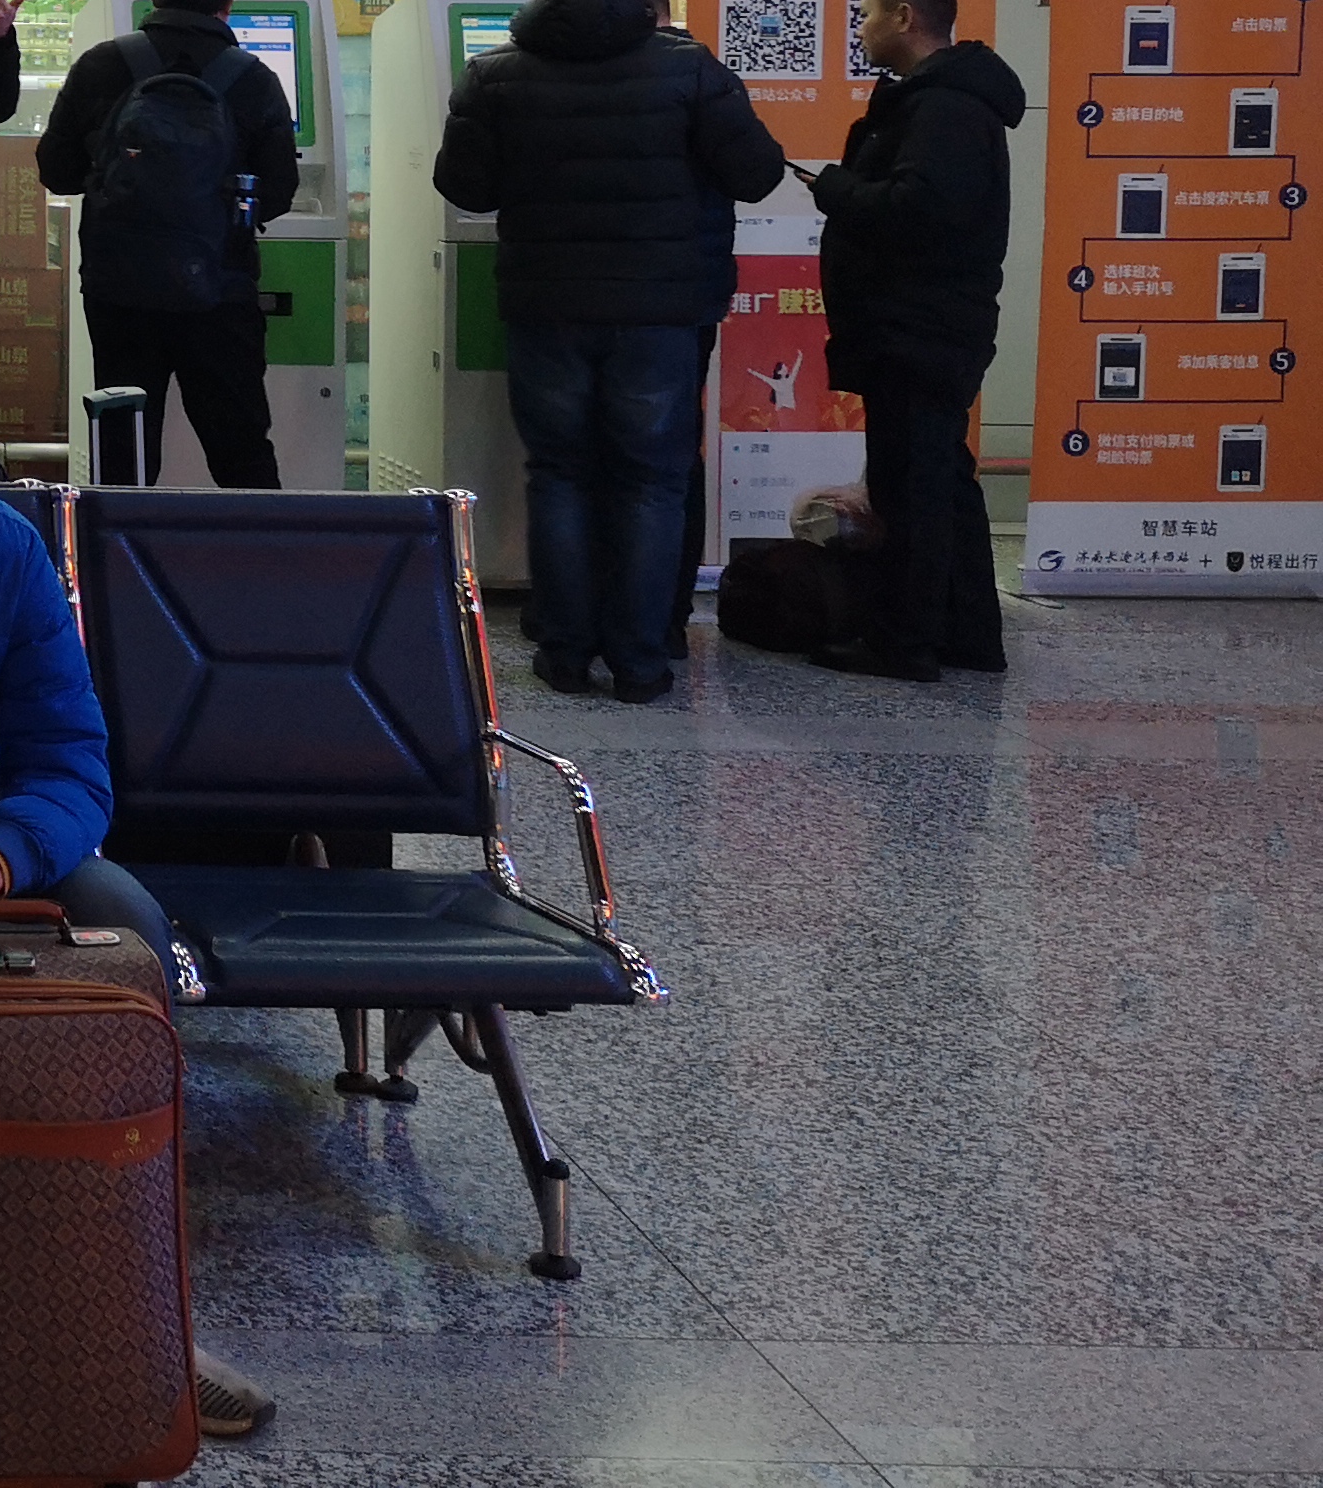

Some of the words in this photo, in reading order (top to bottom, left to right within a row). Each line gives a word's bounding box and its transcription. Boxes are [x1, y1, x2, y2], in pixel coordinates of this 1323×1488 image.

[1230, 17, 1287, 32] 点击购票
[1082, 105, 1098, 124] 2
[1111, 107, 1184, 123] 选择目的地
[1173, 190, 1270, 206] 点击搜索汽车票
[1285, 187, 1300, 206] 3
[1073, 269, 1088, 288] 4
[1103, 264, 1161, 279] 选择班次
[1102, 280, 1175, 296] 输入手机号
[1275, 352, 1290, 371] 5
[1068, 434, 1084, 452] 6
[1141, 519, 1219, 538] 智慧车站
[1249, 553, 1319, 570] 悦程出行
